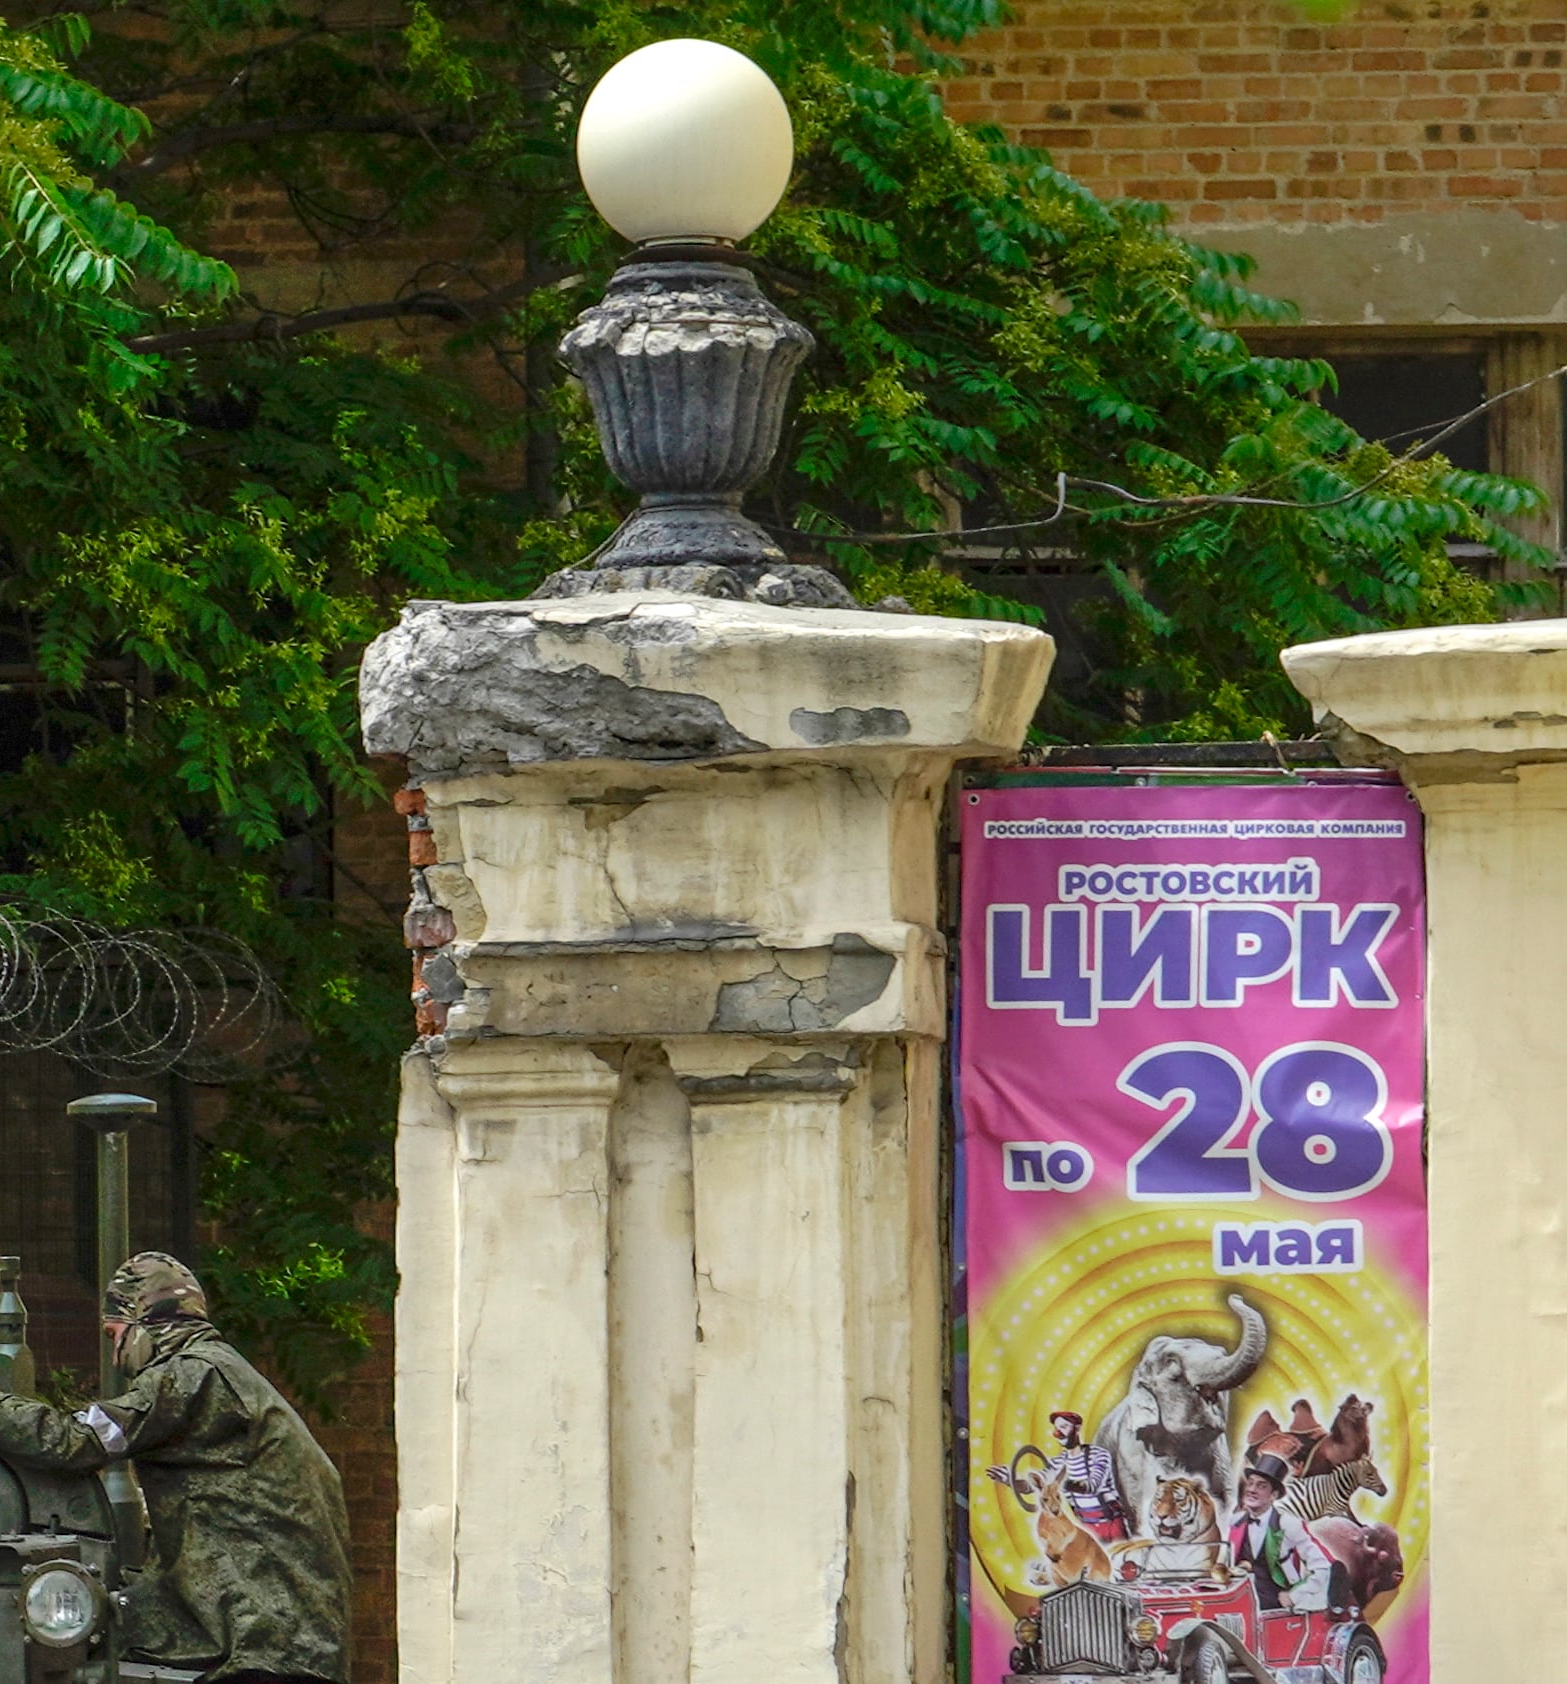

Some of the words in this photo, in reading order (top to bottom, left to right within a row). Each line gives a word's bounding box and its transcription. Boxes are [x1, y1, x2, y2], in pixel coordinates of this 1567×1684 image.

[987, 822, 1082, 835] РОССИЙСКАЯ
[1089, 824, 1228, 836] ГОСУДАРСТВЕННАЯ
[1234, 823, 1315, 836] ЦИРКОВАЯ
[1321, 823, 1403, 835] КОМПАНИЯ
[1065, 864, 1313, 896] РОСТОВСКИЙ
[992, 909, 1392, 1020] ЦИРК
[1011, 1149, 1085, 1183] по
[1125, 1048, 1385, 1194] 28
[1220, 1227, 1356, 1267] мая
